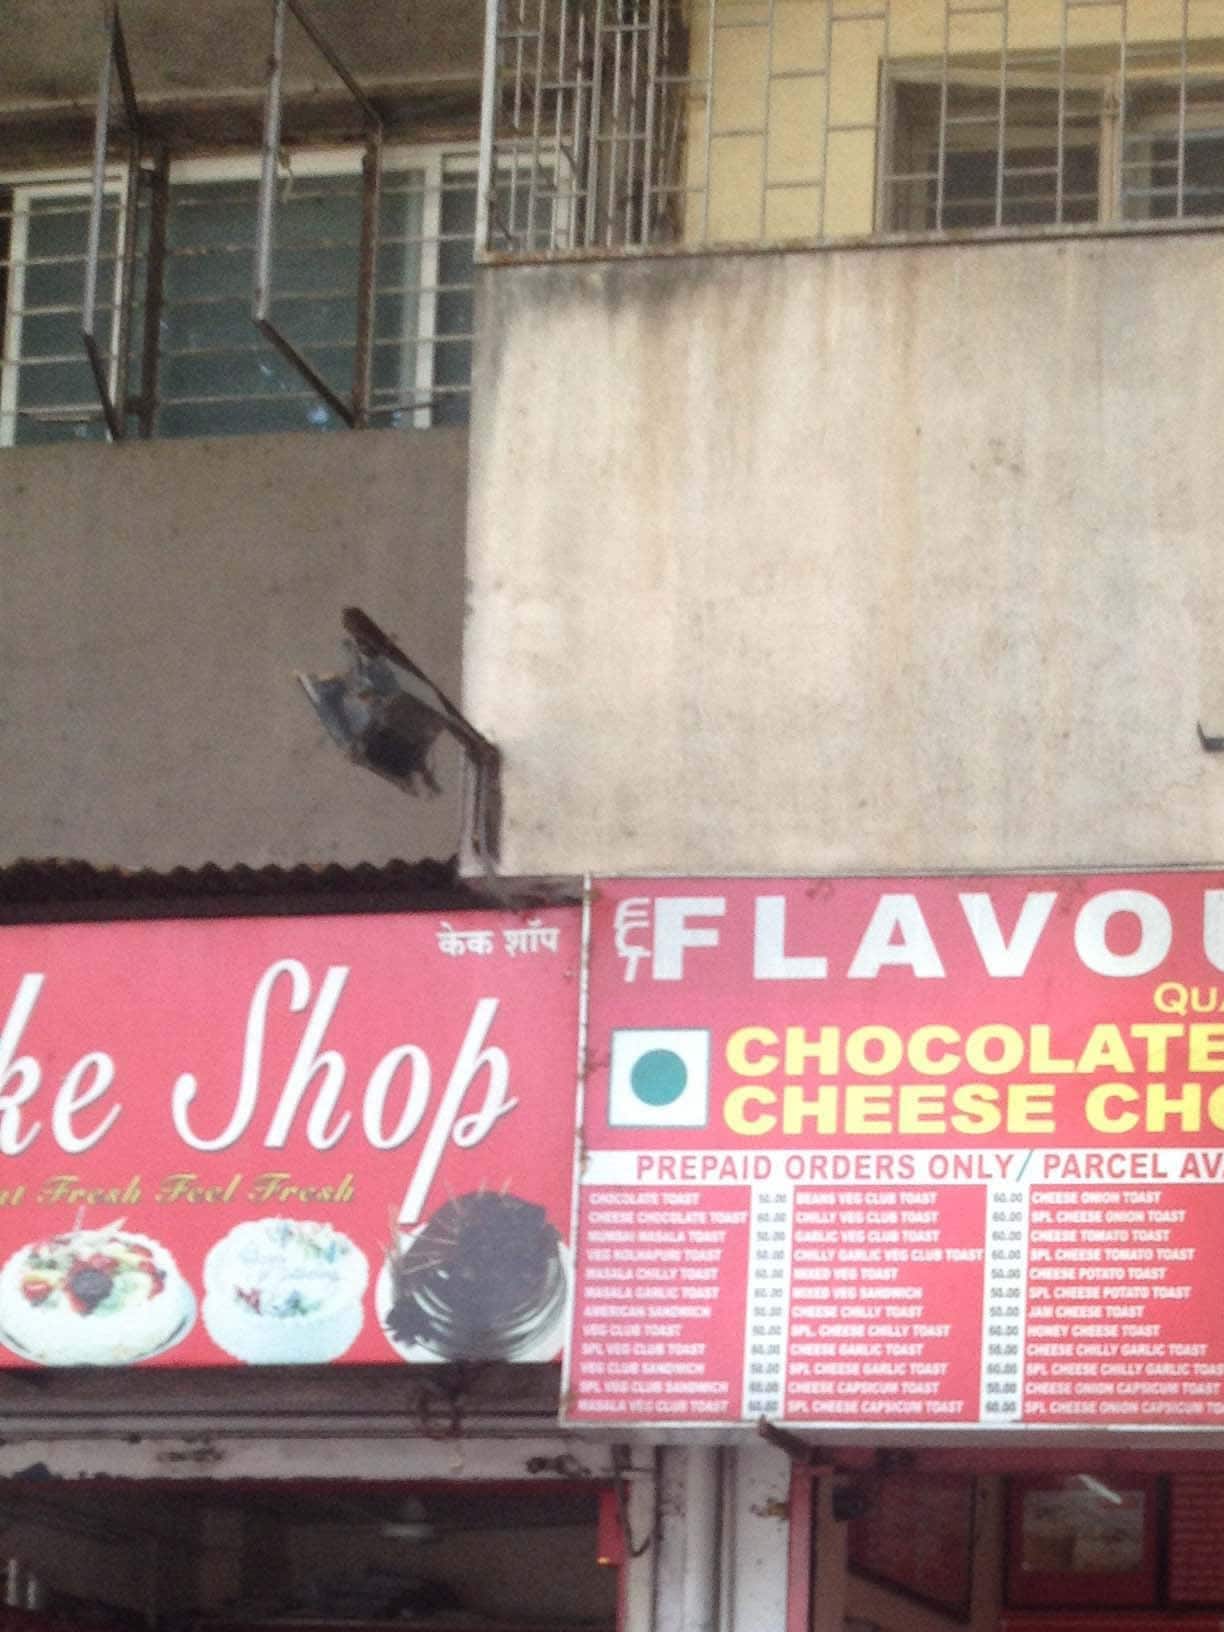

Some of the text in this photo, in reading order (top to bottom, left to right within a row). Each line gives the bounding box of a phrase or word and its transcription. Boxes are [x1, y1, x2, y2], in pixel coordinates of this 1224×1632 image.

[435, 918, 560, 957] केक शॉप
[171, 958, 519, 1223] Shop
[722, 1084, 1057, 1136] CHEESE
[636, 1154, 773, 1181] PREPAID
[785, 1153, 915, 1181] ORDERS
[1043, 1153, 1168, 1180] PARCEL
[37, 1174, 141, 1205] Fresh
[155, 1172, 242, 1205] Feel
[249, 1172, 355, 1204] Fresh
